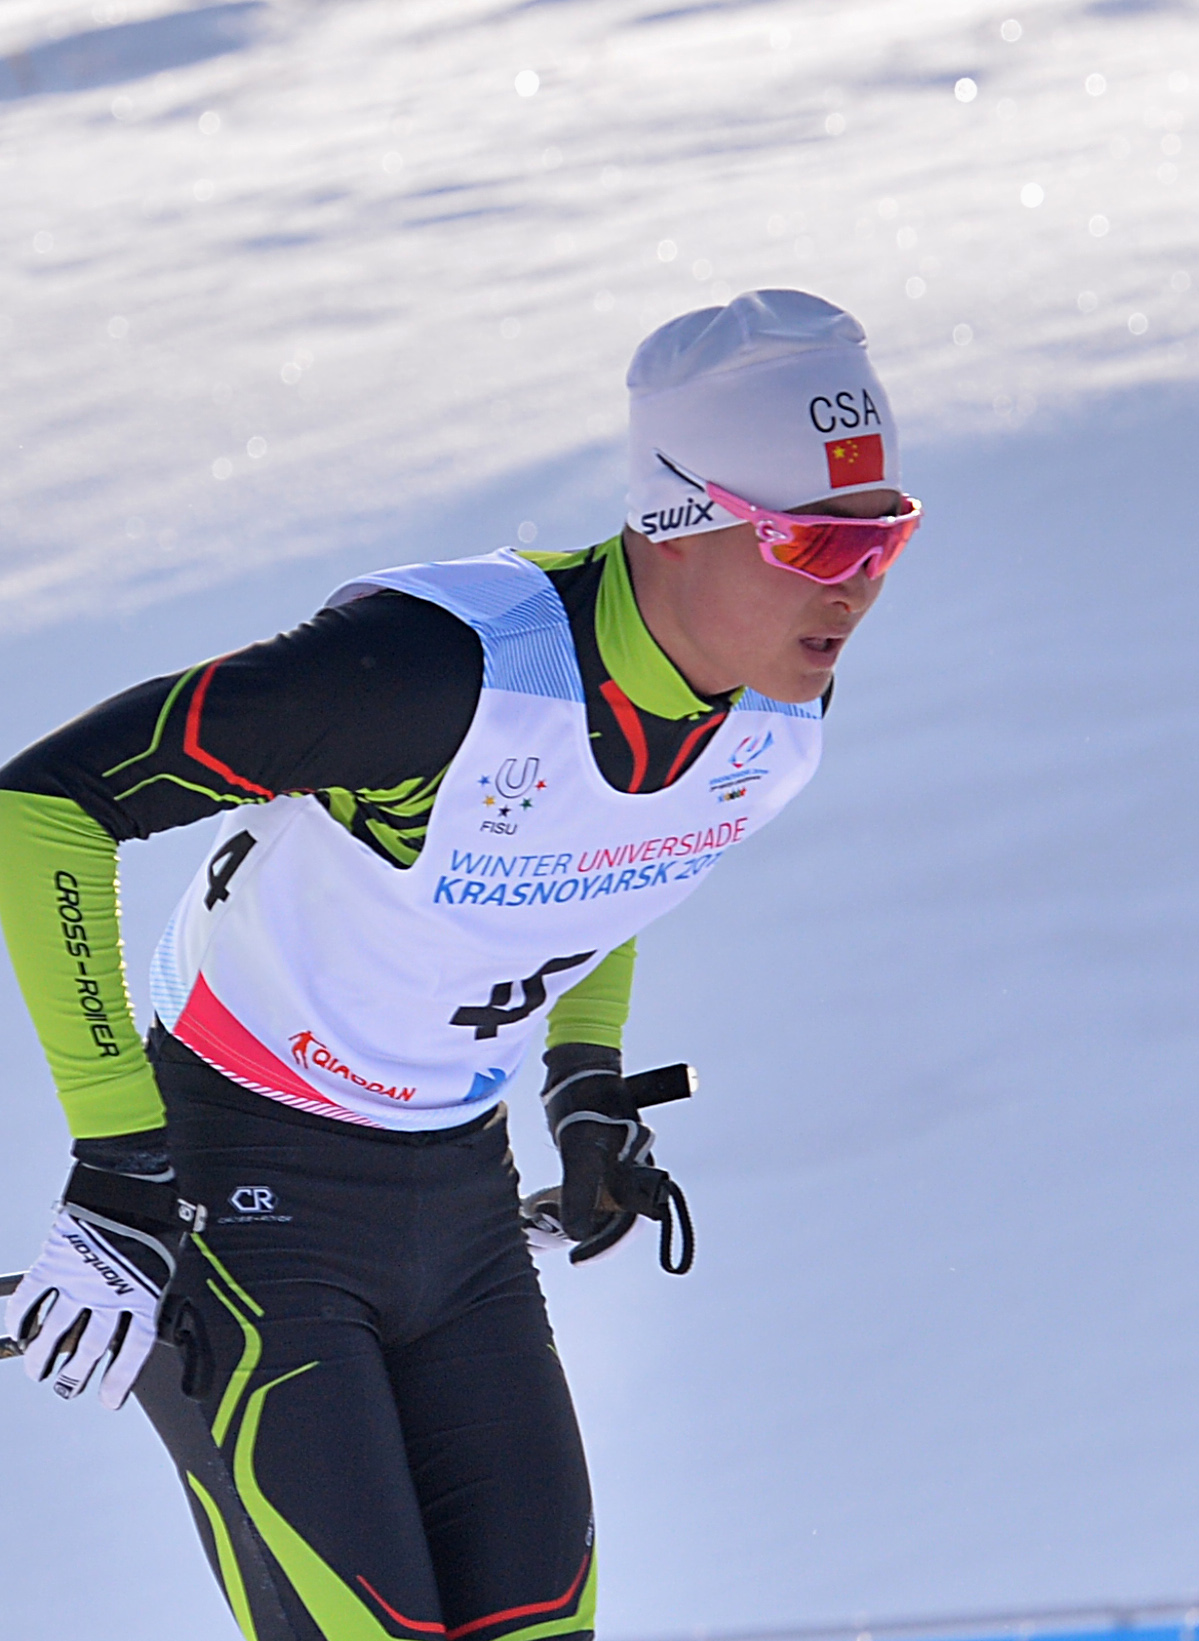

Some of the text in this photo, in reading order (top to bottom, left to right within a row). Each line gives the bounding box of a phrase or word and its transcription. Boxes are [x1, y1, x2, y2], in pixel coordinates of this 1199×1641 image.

[809, 388, 881, 433] CSA
[641, 498, 714, 536] swix
[449, 817, 749, 878] WINTER UNIVERSIADE
[480, 820, 518, 836] FISU
[204, 829, 258, 912] 4
[433, 860, 679, 907] KRASNOYARSK
[231, 1189, 275, 1211] CR
